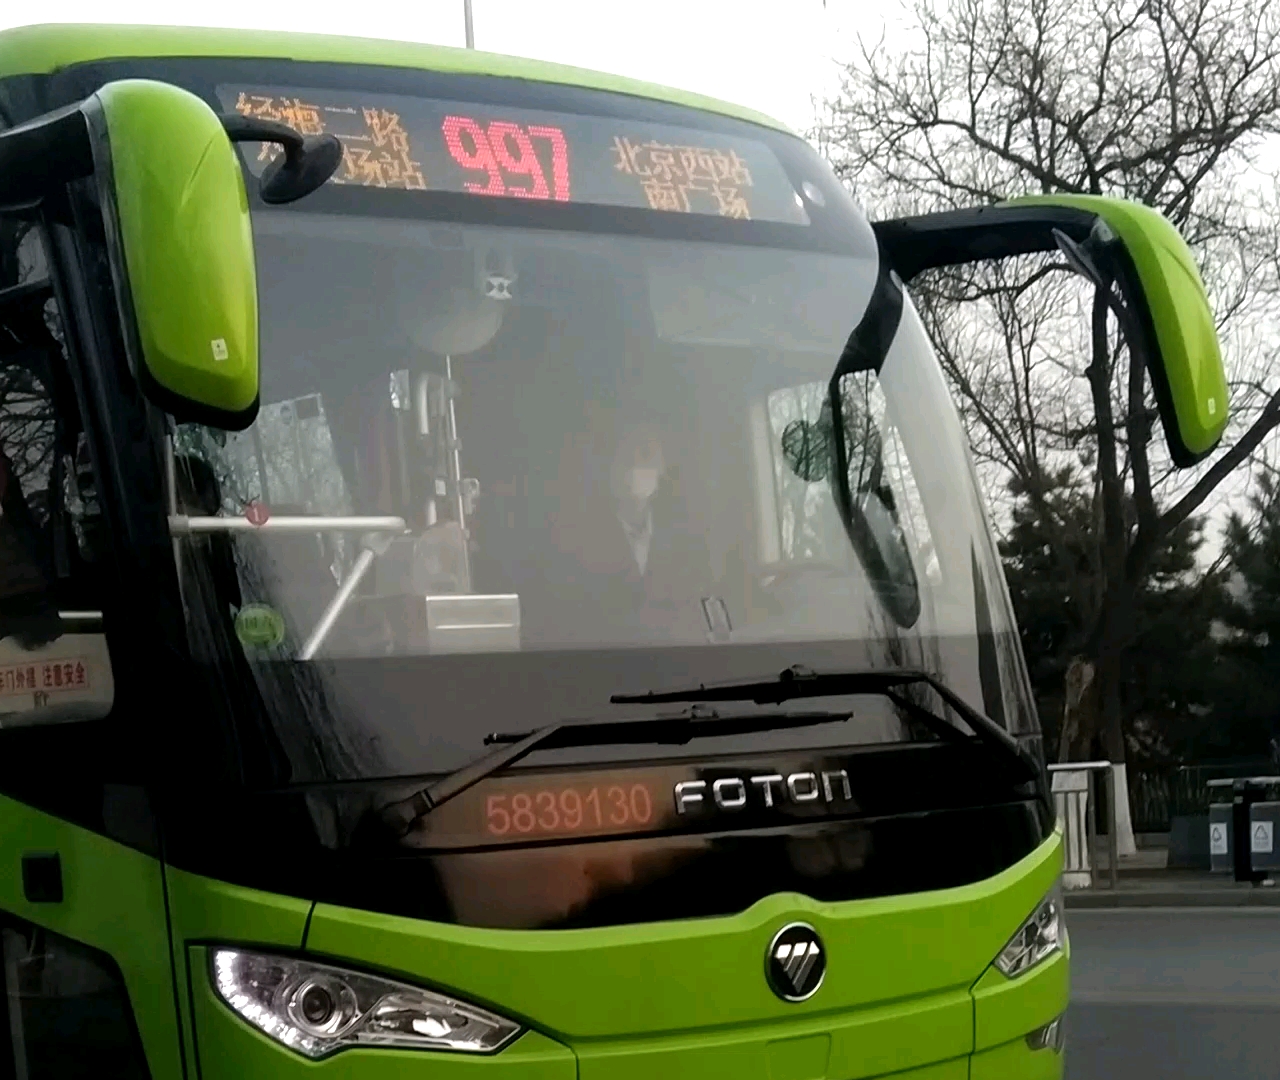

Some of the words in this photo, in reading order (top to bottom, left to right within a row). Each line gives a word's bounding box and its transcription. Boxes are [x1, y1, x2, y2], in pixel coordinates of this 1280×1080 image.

[236, 92, 410, 151] 经海二路
[442, 116, 569, 201] 997
[609, 136, 754, 187] 北京西站
[640, 180, 751, 220] 南广场
[43, 661, 86, 687] 注意安全
[486, 783, 653, 836] 5839130
[674, 769, 852, 816] FOTON
